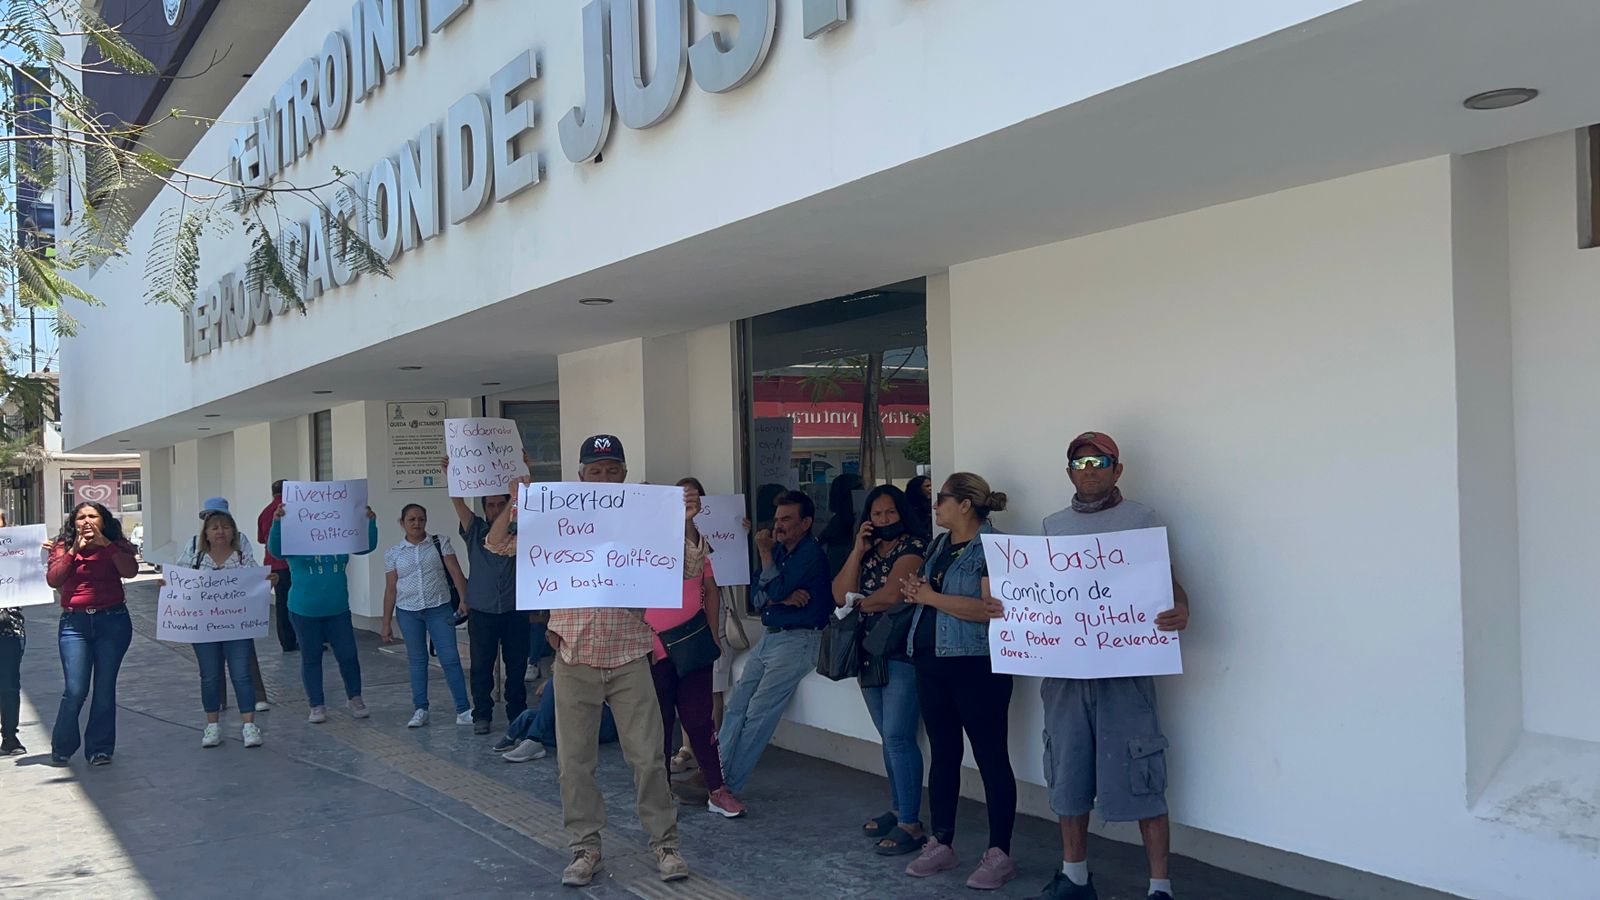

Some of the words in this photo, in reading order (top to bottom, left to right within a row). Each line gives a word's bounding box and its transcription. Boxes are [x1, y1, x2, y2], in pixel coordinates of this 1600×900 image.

[229, 31, 348, 213] CENTRO
[448, 49, 539, 223] DE
[466, 464, 486, 474] NO
[298, 507, 341, 522] Presos
[310, 527, 360, 541] Politicos
[529, 545, 595, 567] Presos
[606, 548, 678, 570] Politicos
[169, 570, 239, 590] Presidente
[166, 590, 178, 600] de
[182, 592, 191, 600] la
[1001, 580, 1079, 605] Comicion
[1088, 580, 1112, 600] de
[163, 605, 204, 617] Andres
[210, 606, 247, 617] Manuel
[1074, 604, 1147, 636] quitale
[1025, 630, 1061, 647] Poder
[1074, 636, 1088, 647] a
